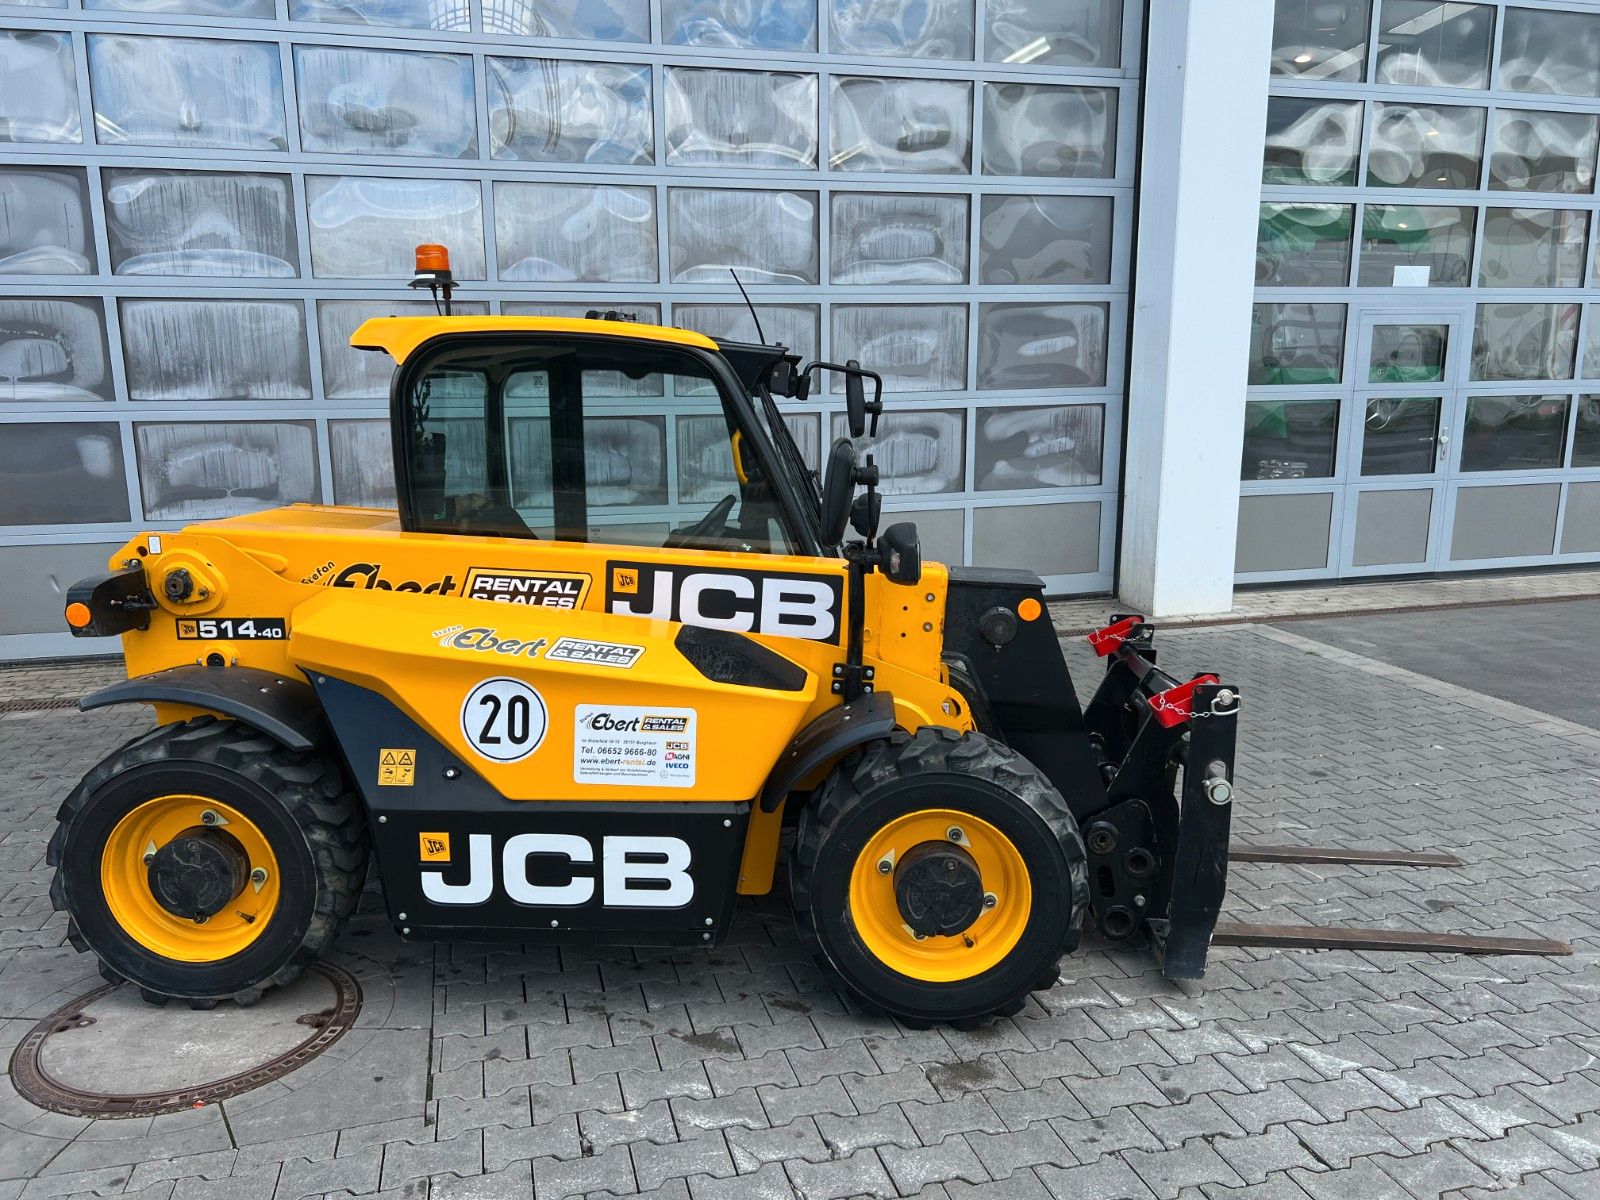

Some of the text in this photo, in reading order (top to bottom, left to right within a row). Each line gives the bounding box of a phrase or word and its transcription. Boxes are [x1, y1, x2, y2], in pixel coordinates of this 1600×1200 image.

[473, 576, 579, 594] RENTAL
[612, 570, 835, 640] JCB
[453, 628, 546, 656] Ebert
[560, 641, 634, 656] RENTAL
[570, 650, 631, 664] SALES
[479, 694, 530, 745] 20
[591, 712, 640, 732] Ebert
[581, 746, 657, 757] Tel. 06652 9666-80
[666, 742, 689, 750] JCB
[580, 758, 657, 767] www.ebert-rental.de
[664, 752, 690, 760] MAGNI
[428, 840, 446, 854] JCB
[421, 833, 694, 907] JCB
